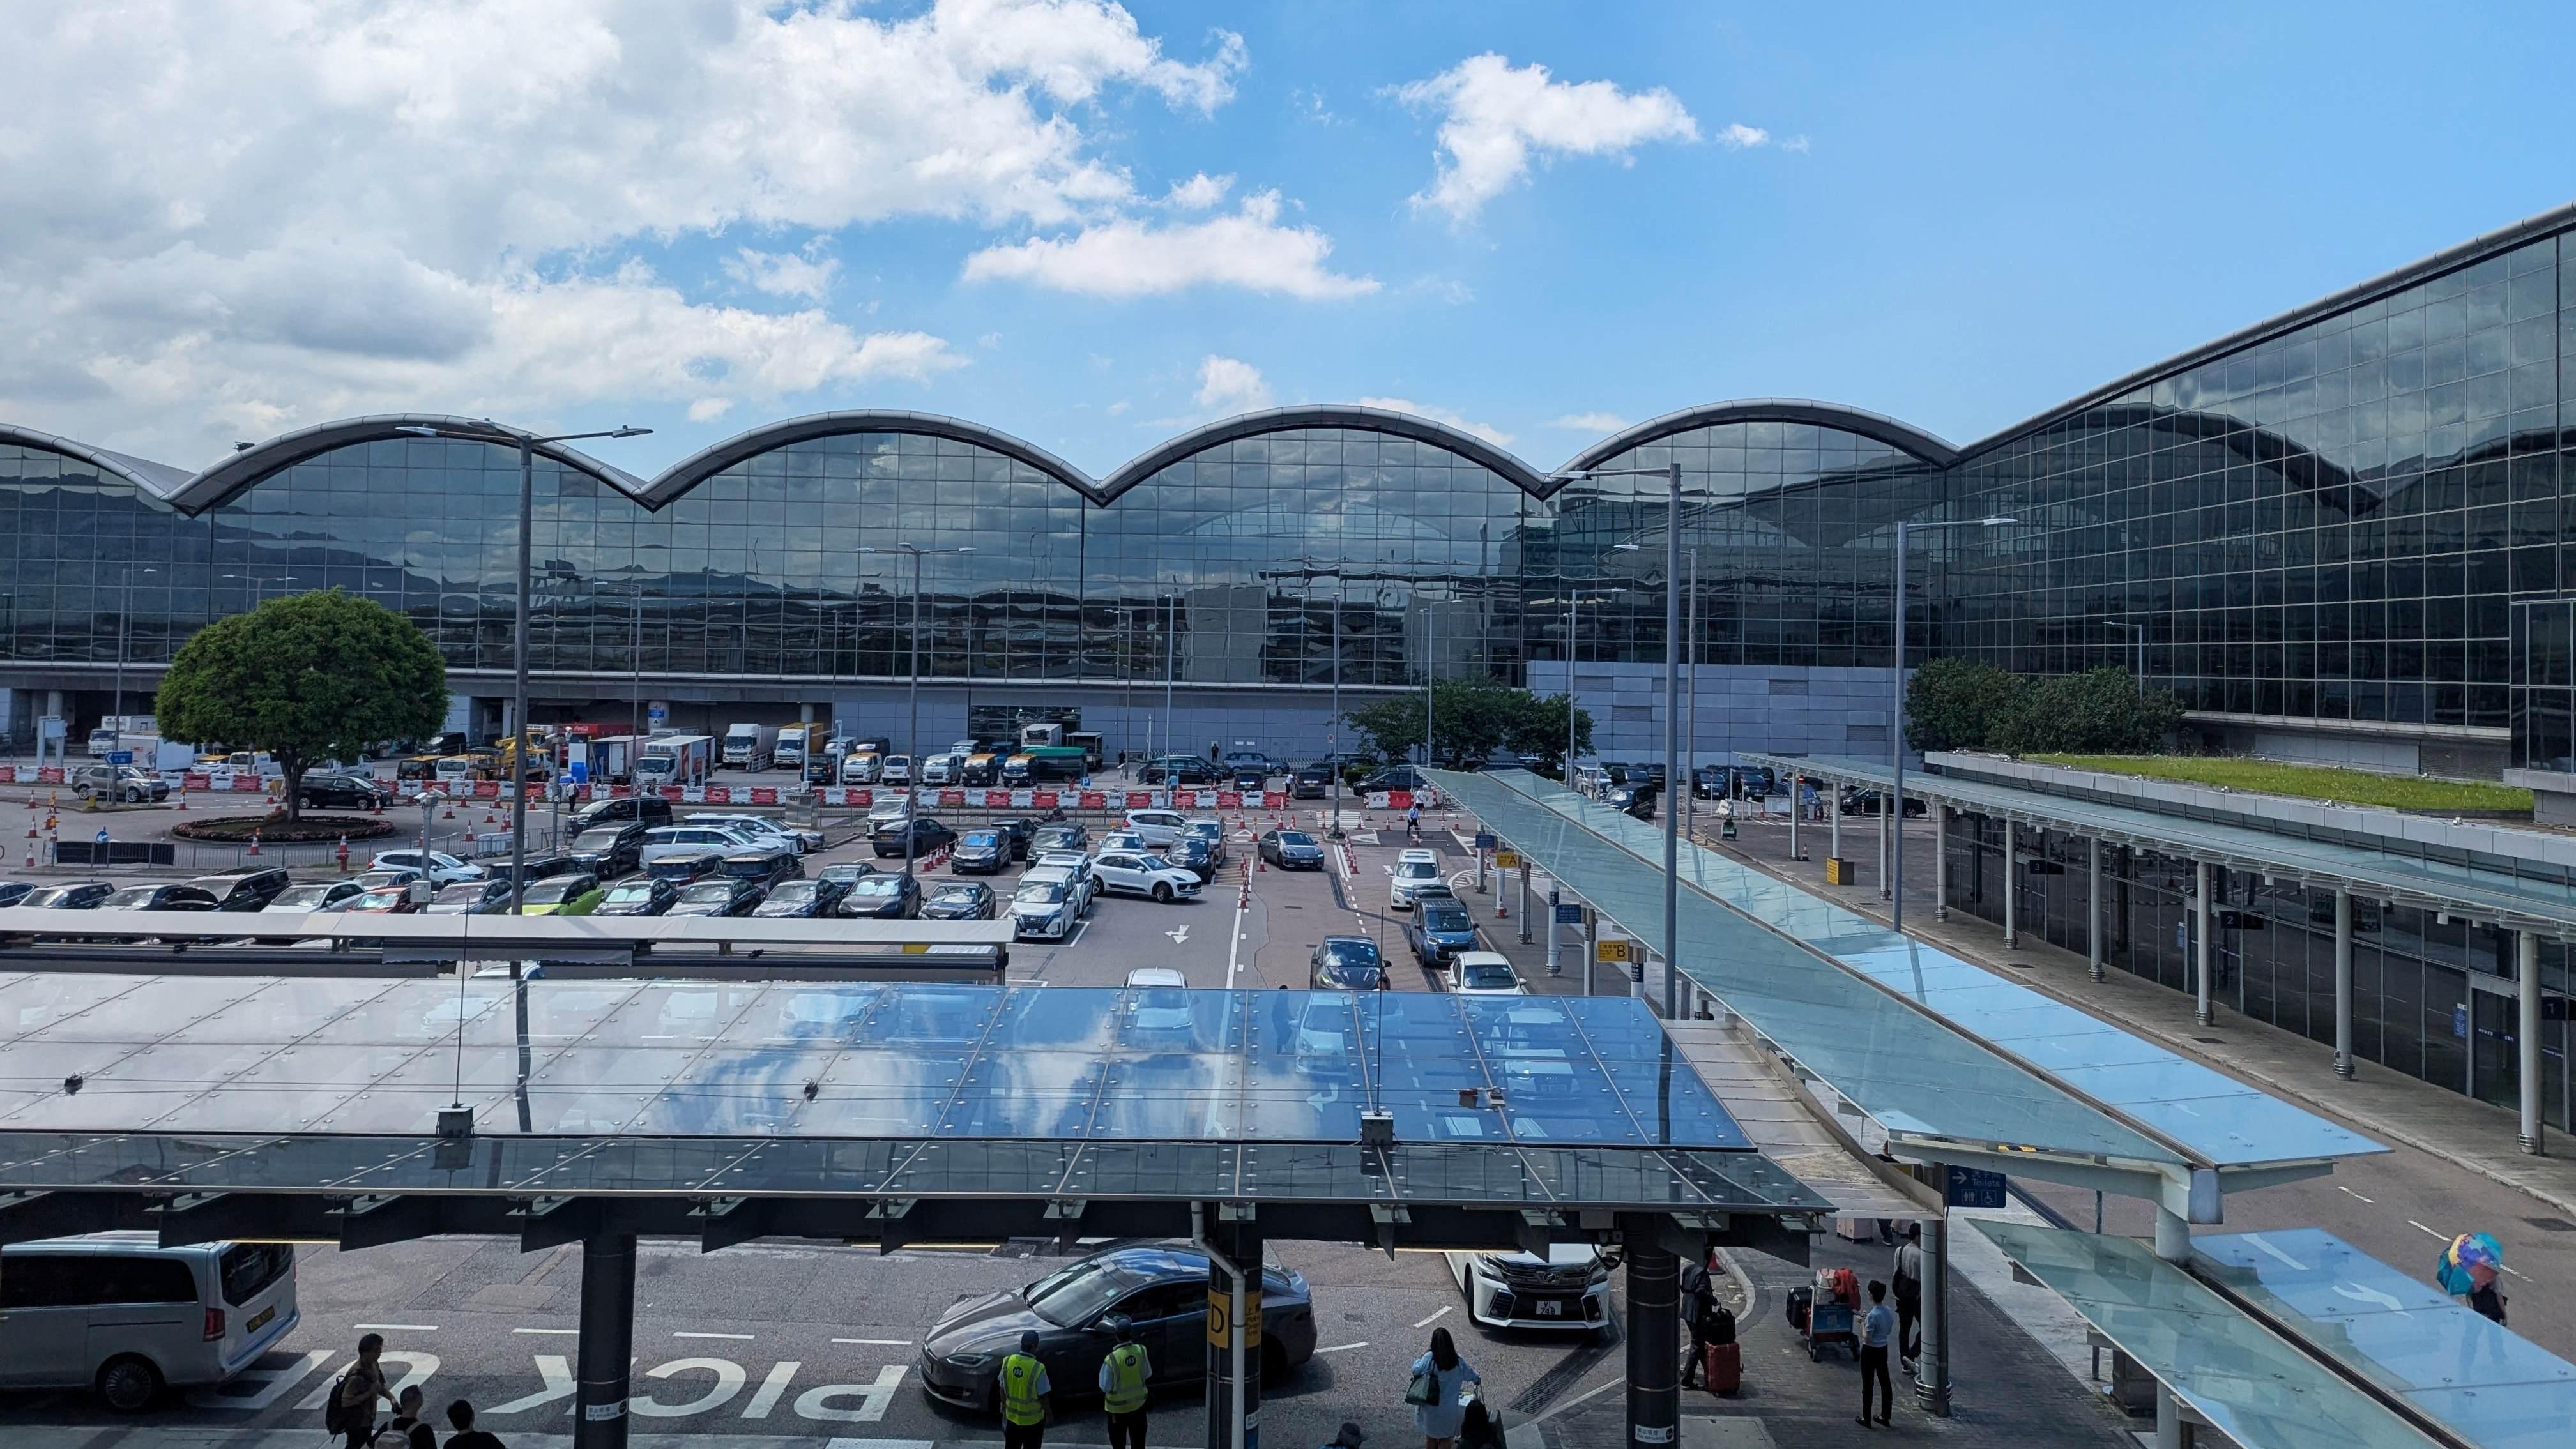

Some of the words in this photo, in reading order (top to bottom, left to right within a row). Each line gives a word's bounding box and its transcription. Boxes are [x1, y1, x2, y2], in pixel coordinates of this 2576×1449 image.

[1509, 856, 1517, 865] A
[2227, 916, 2234, 924] 2
[1617, 945, 1626, 957] B
[2547, 1003, 2554, 1014] 1
[1972, 1178, 2001, 1187] Toilets
[1211, 1303, 1224, 1333] D
